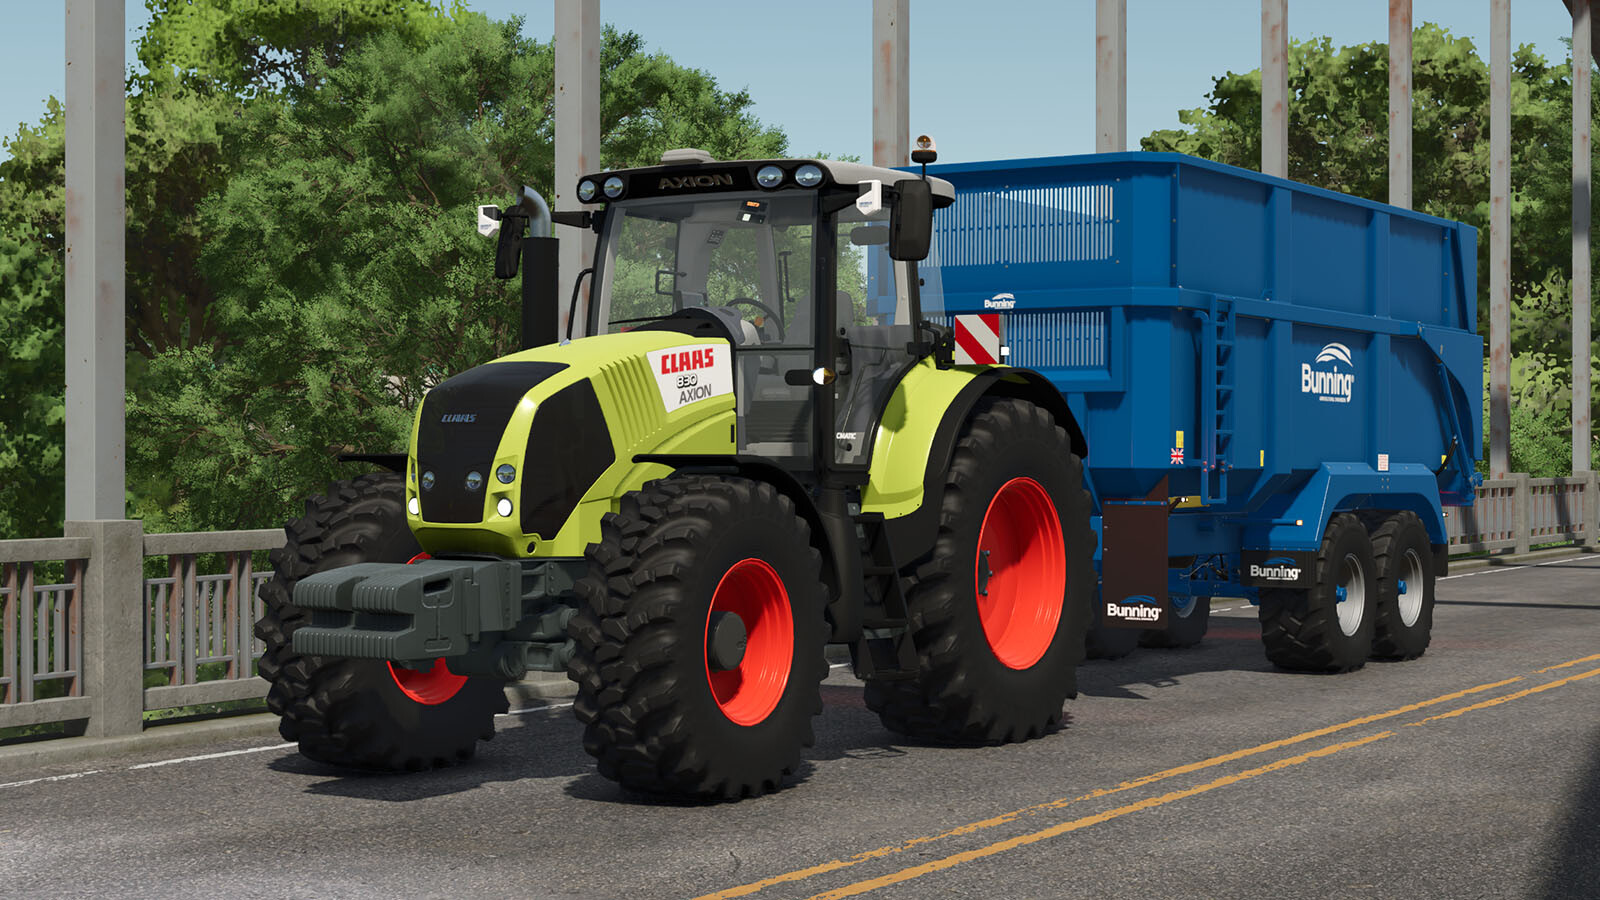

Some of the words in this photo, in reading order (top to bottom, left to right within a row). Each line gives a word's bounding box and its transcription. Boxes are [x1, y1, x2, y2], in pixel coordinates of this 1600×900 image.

[658, 173, 733, 190] AXION
[984, 299, 1015, 309] Bunning
[661, 347, 714, 375] CLAAS
[676, 374, 698, 389] 830
[1301, 363, 1352, 403] Bunning
[678, 383, 712, 404] AXION
[441, 413, 477, 423] CLAAS
[1250, 564, 1299, 581] Bunning
[1107, 603, 1159, 621] Bunning
